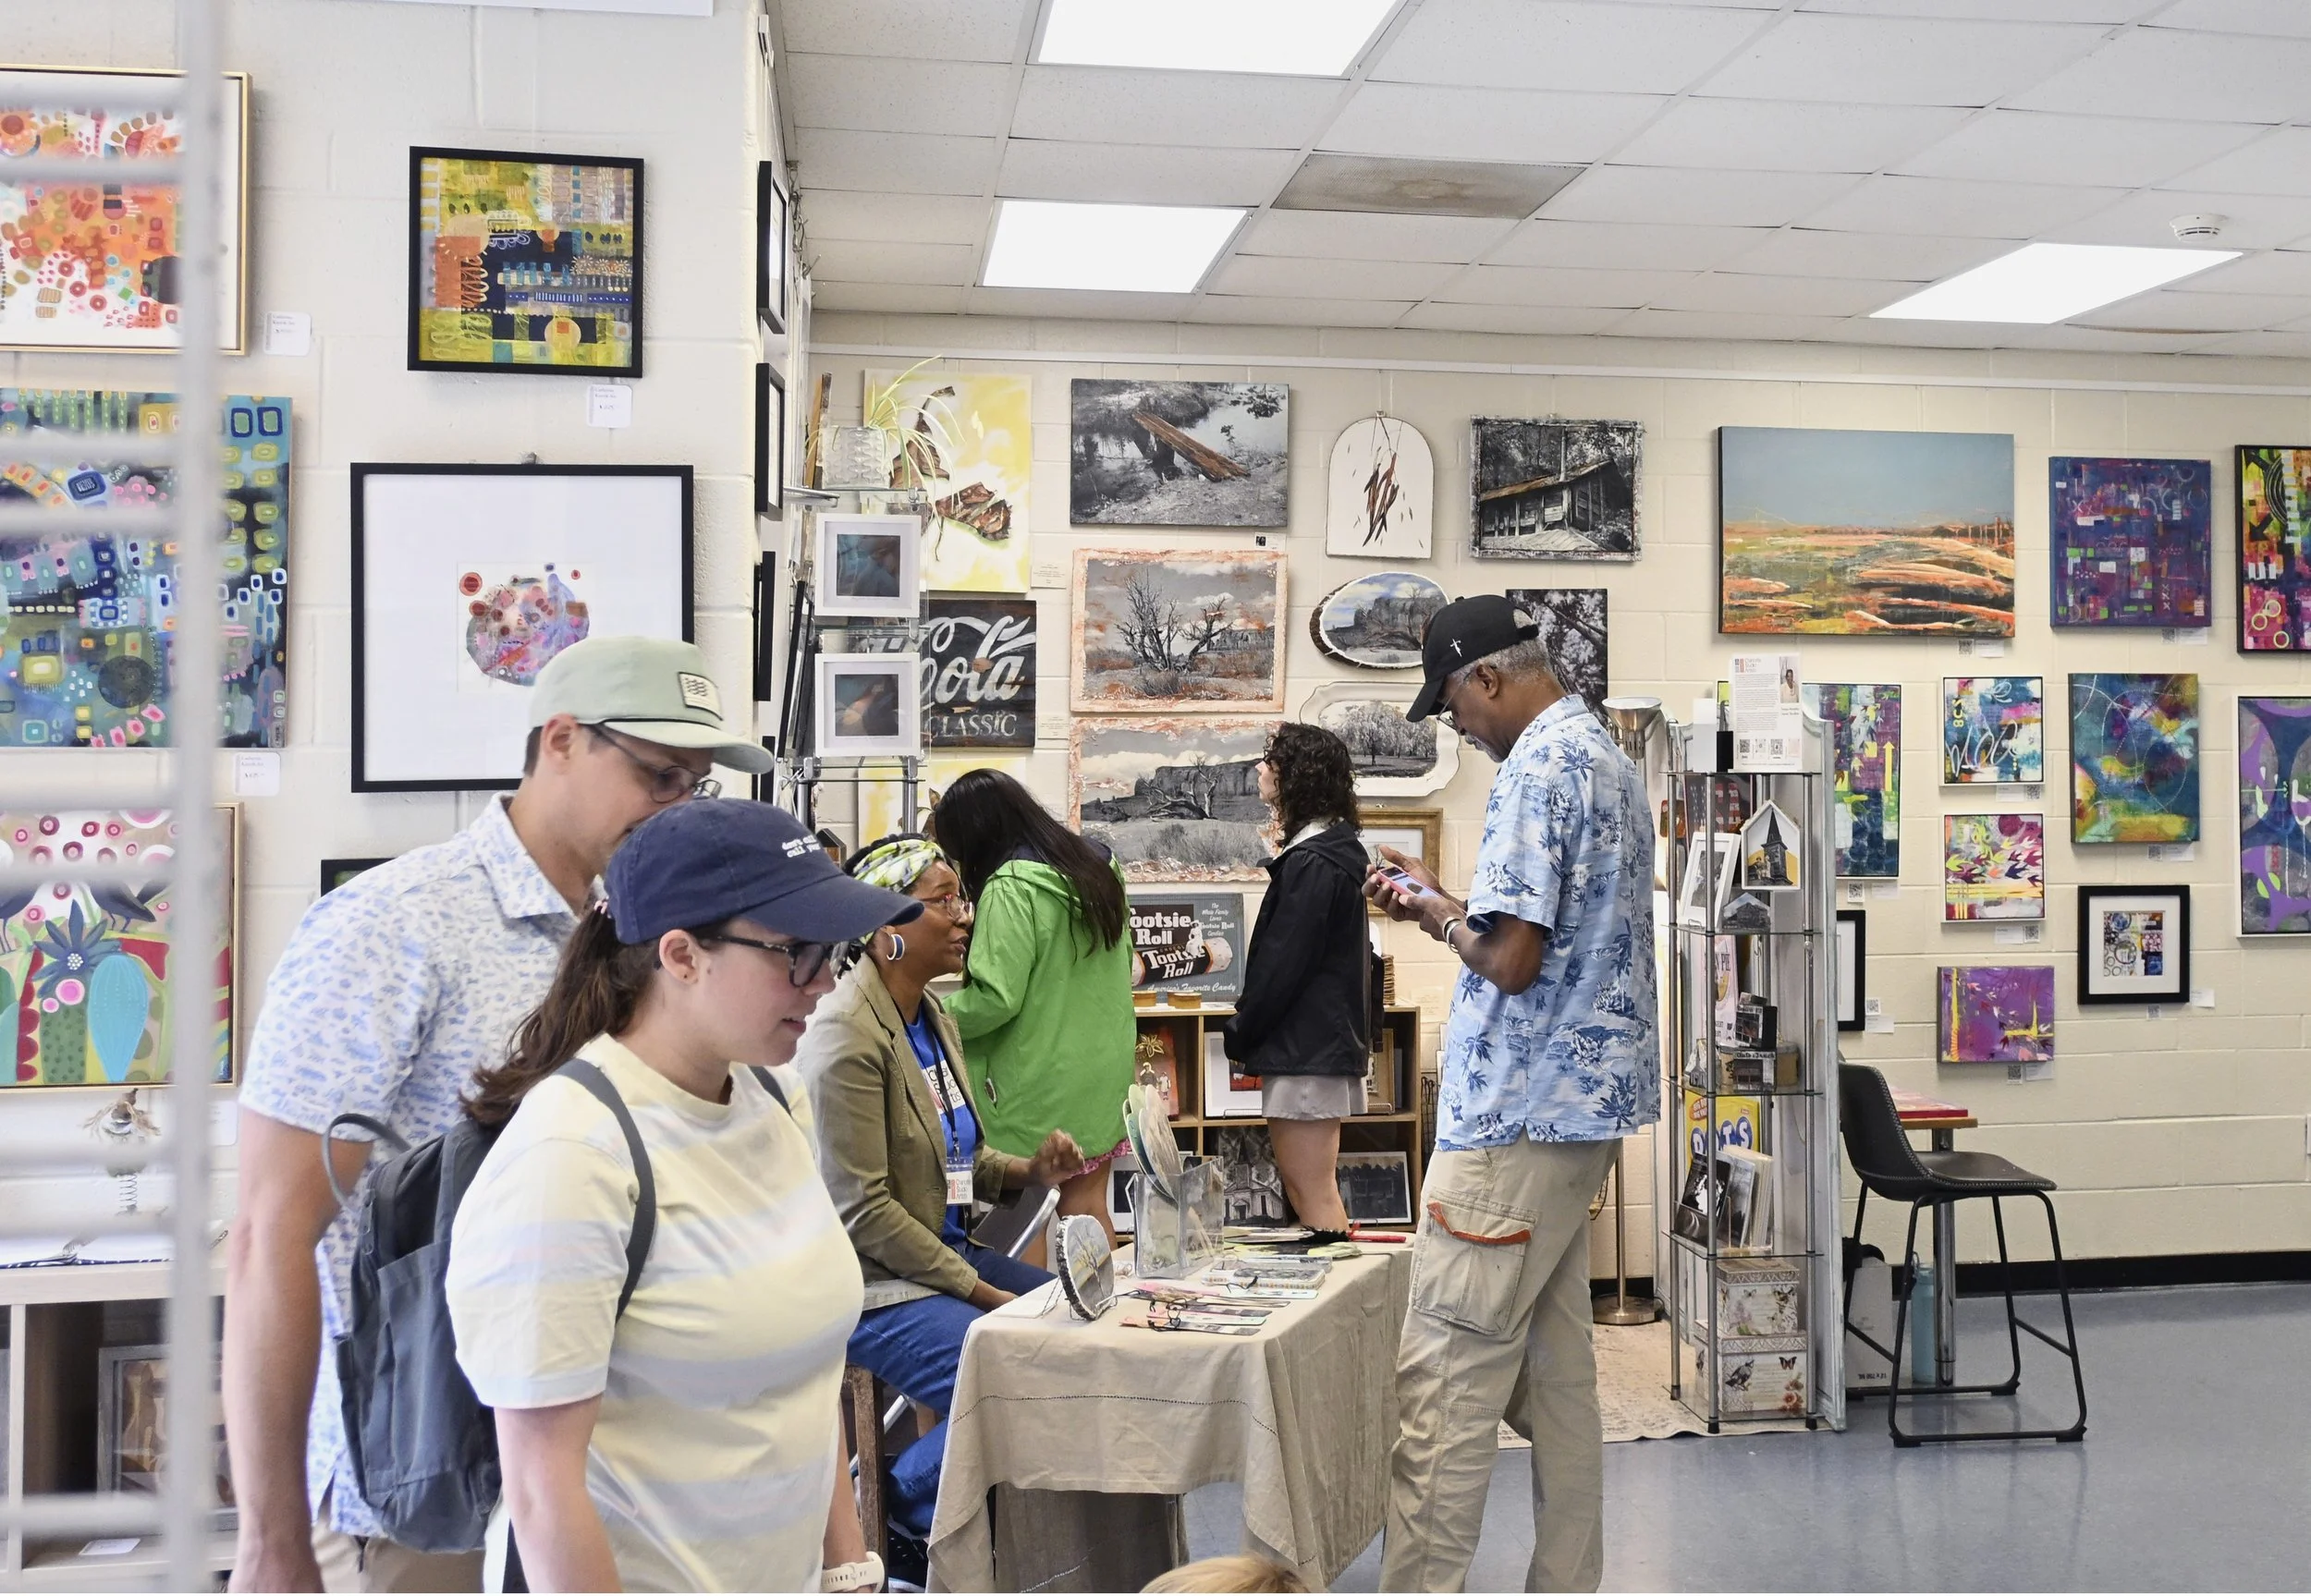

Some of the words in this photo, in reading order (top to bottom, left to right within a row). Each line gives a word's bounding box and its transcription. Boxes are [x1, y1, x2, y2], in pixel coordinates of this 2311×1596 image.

[1129, 908, 1192, 928] ootsie
[1135, 929, 1172, 945] Roll
[1162, 961, 1193, 979] Roll
[1181, 982, 1211, 992] Favorite
[1212, 981, 1236, 993] Candy
